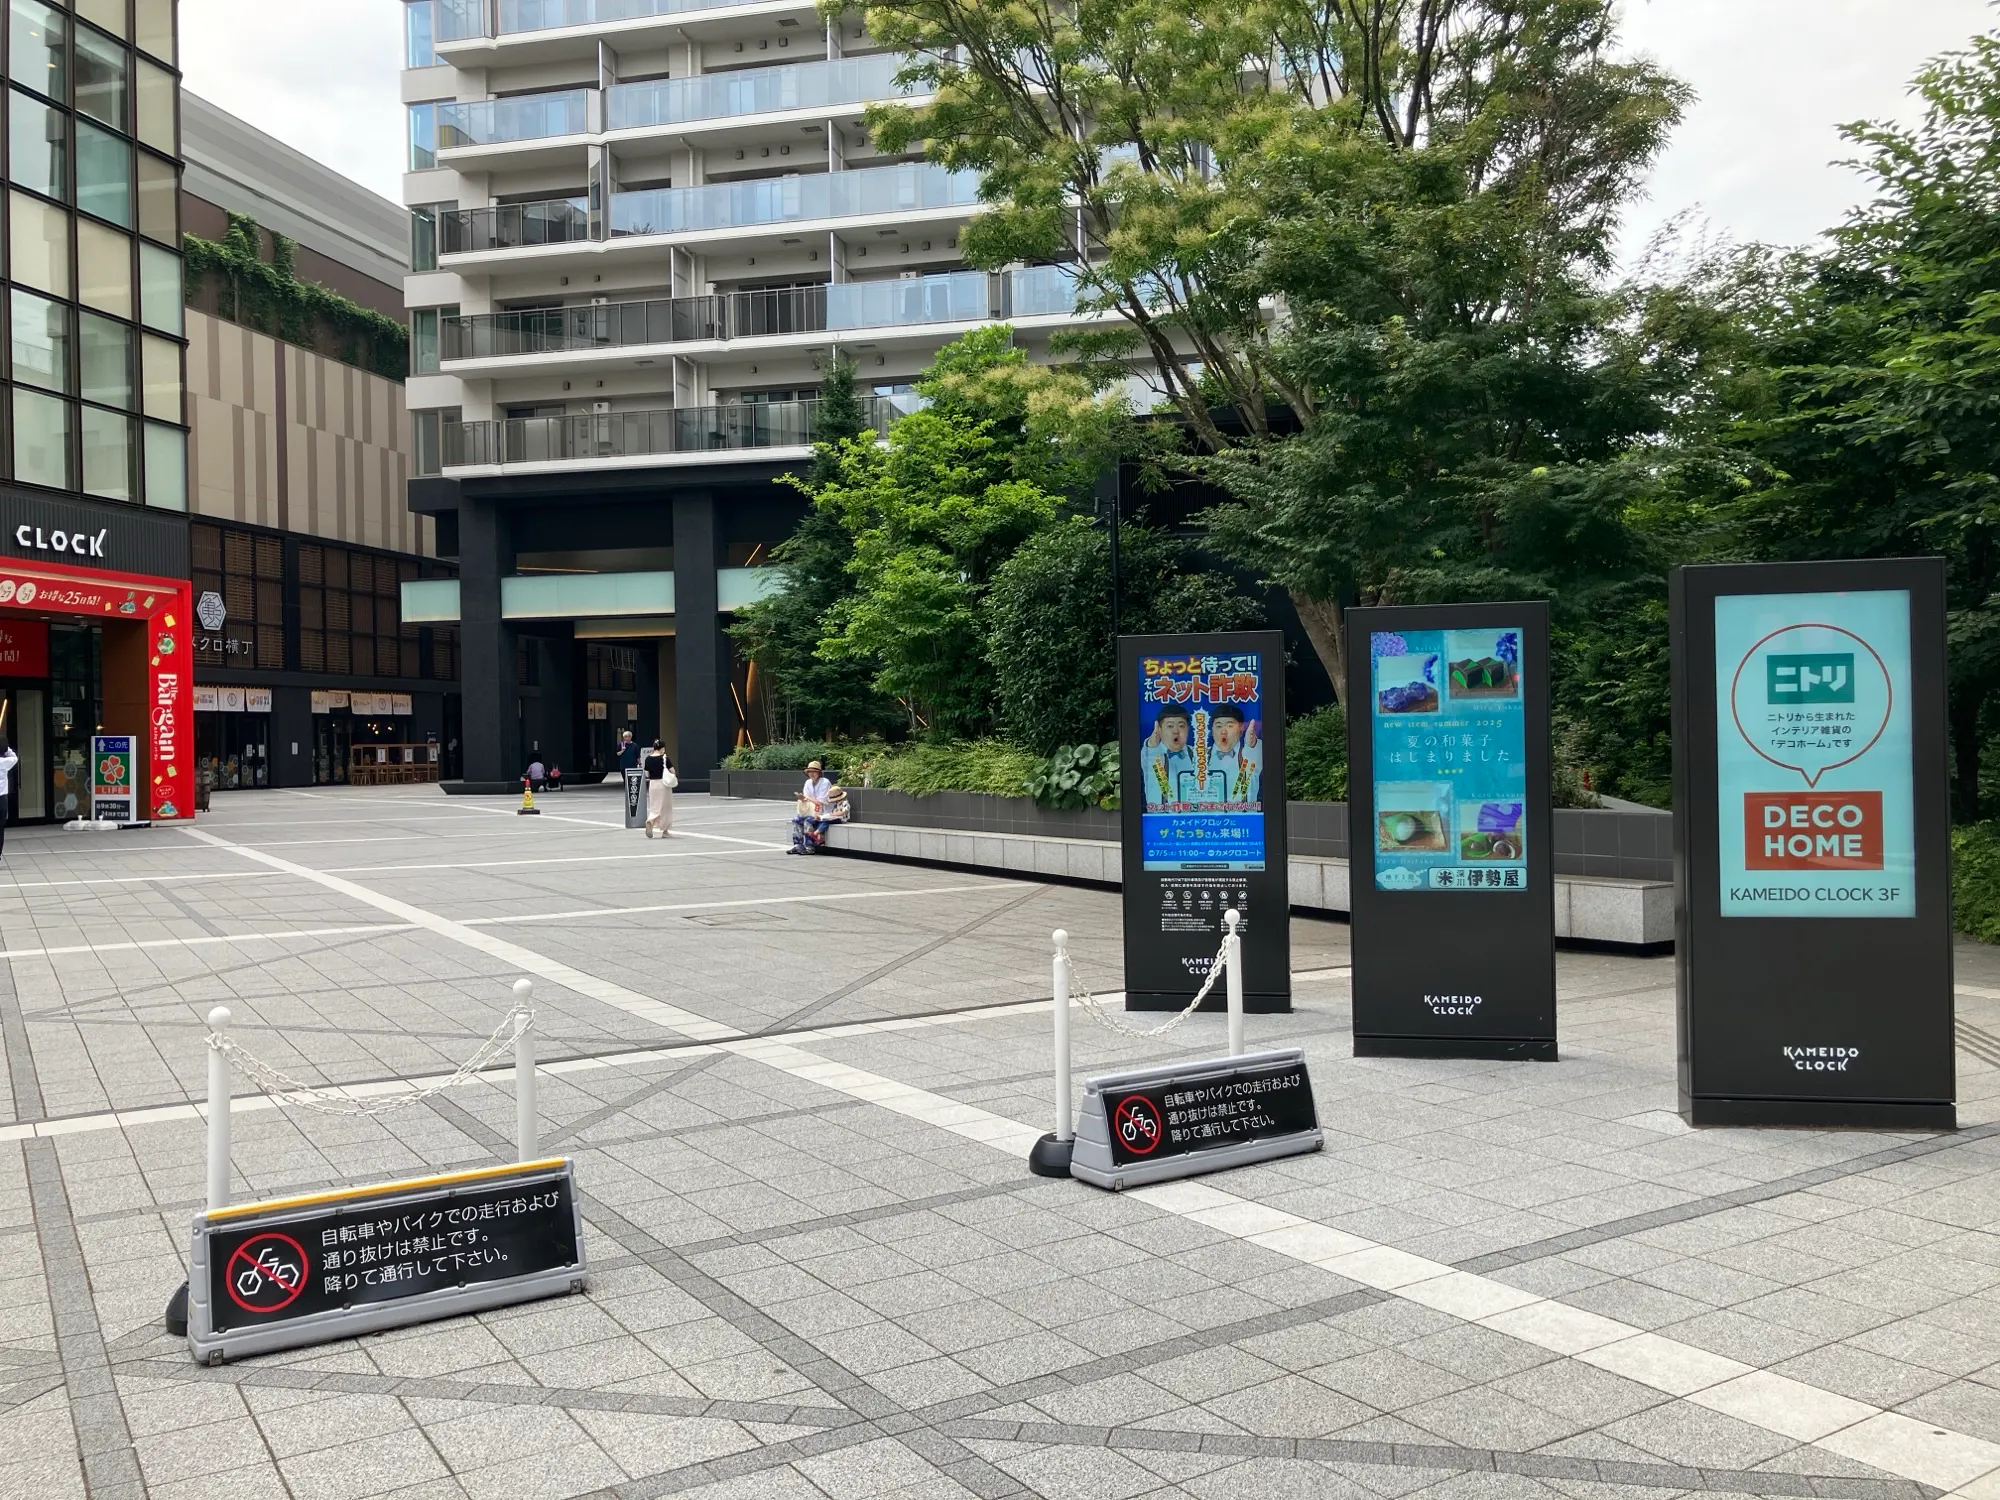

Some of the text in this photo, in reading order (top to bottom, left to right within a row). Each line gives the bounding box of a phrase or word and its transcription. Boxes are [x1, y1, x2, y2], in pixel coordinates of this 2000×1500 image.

[15, 525, 107, 558] CLOCK
[1143, 655, 1257, 675] ちょっと待って!!
[1775, 665, 1846, 693] ニトリ
[1153, 672, 1259, 704] ネット詐欺
[152, 673, 178, 761] Bargain
[1434, 720, 1470, 728] summer
[1477, 719, 1502, 728] 2025
[1768, 711, 1856, 722] ニトリから生まれた
[1772, 725, 1852, 735] インテリア雑貨の
[108, 741, 129, 749] この先
[1407, 733, 1492, 749] 夏の和菓子
[1771, 738, 1852, 749] 「デコホーム」です
[1390, 749, 1510, 763] はじまりました
[101, 786, 124, 794] LIFE
[1764, 804, 1863, 829] DECO
[1159, 828, 1250, 839] ザ・たっちさん来場!!
[1765, 834, 1863, 857] HOME
[1467, 869, 1520, 887] 伊勢屋
[1730, 887, 1900, 901] KAMEIDO CLOCK 3F
[1181, 957, 1217, 967] KAMEI
[1424, 995, 1482, 1006] KAMEIDO
[1432, 1004, 1475, 1015] CLOCK
[1783, 1046, 1859, 1060] KAMEIDO
[1795, 1058, 1849, 1071] CLOCK
[1164, 1073, 1301, 1108] 自転車やバイクでの走行および
[1167, 1098, 1262, 1126] 通り抜けは禁止です。
[1171, 1114, 1276, 1144] 降りて通行して下さい。
[321, 1190, 560, 1247] 自転車やバイクでの走行および
[322, 1230, 490, 1273] 通り抜けは禁止です。
[324, 1249, 509, 1295] 降りて通行して下さい。
